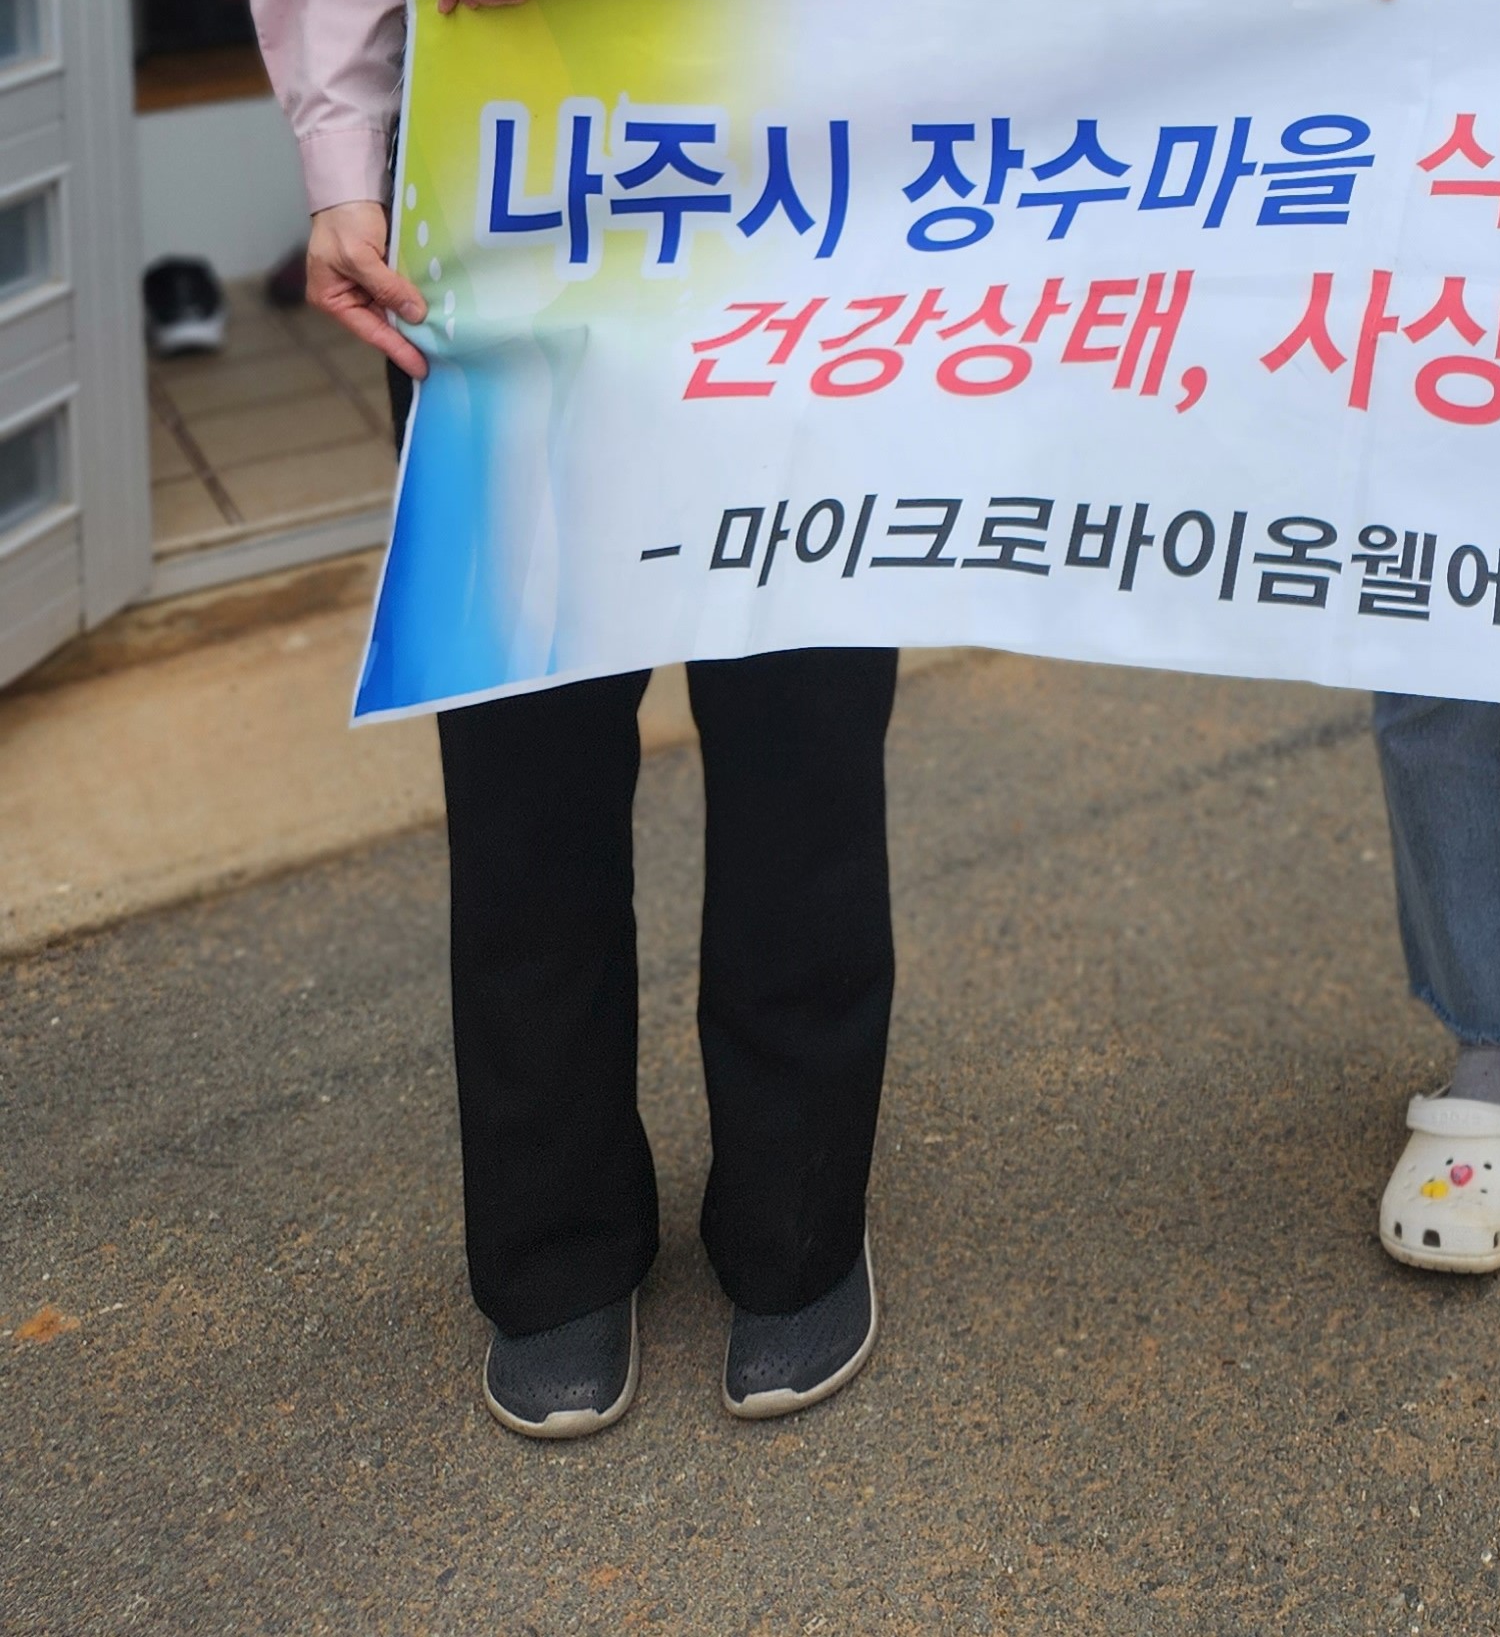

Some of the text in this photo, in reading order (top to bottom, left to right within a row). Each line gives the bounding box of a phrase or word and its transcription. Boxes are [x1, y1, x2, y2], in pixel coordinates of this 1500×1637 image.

[490, 116, 848, 263] 나주시
[903, 114, 1374, 252] 장수마을
[683, 270, 1207, 413] 건강상태,
